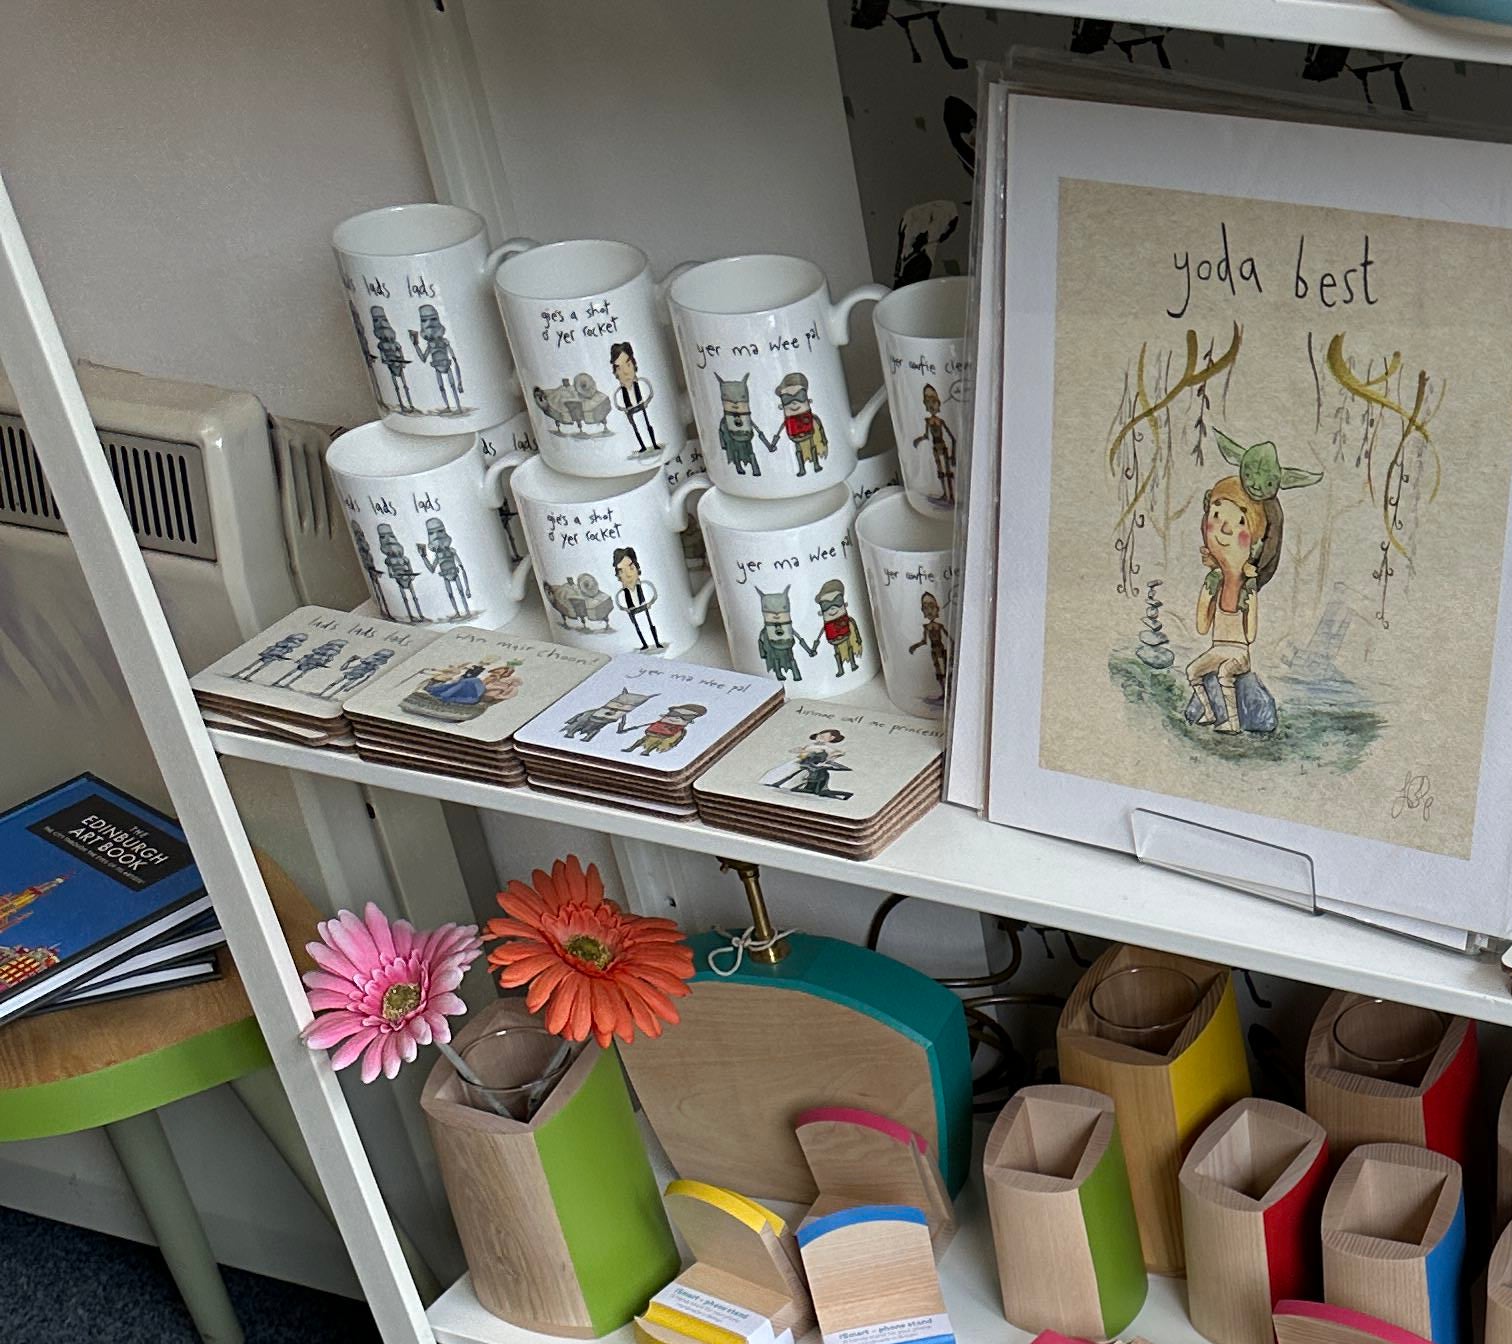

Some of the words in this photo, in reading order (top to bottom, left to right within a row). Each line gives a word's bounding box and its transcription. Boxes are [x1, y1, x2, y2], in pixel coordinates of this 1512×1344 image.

[1167, 222, 1263, 318] yoda
[1295, 234, 1378, 308] best
[361, 274, 391, 299] lads
[407, 275, 436, 298] lads
[570, 311, 579, 321] a
[586, 299, 611, 319] shot
[556, 330, 576, 348] yer
[582, 316, 619, 338] rocket
[696, 343, 721, 369] yer
[732, 345, 759, 356] ma
[769, 335, 800, 352] wee
[805, 320, 821, 352] pal
[512, 431, 539, 453] lads
[367, 495, 398, 517] lads
[412, 492, 442, 514] lads
[574, 516, 582, 526] a
[589, 507, 614, 525] shot
[561, 533, 579, 550] yer
[585, 523, 623, 542] rocket
[735, 559, 763, 584] yer
[773, 557, 800, 571] ma
[809, 546, 838, 562] wee
[841, 527, 854, 560] pal
[884, 567, 900, 587] yer
[310, 616, 338, 632] lads
[348, 623, 376, 639] lads
[626, 665, 666, 680] yer
[670, 672, 694, 683] ma
[699, 679, 724, 690] wee
[726, 682, 752, 696] pal
[841, 715, 865, 725] call
[869, 720, 886, 728] me
[81, 814, 170, 866] EDINBURGH
[128, 824, 150, 839] THE
[67, 827, 104, 846] ART
[97, 841, 149, 872] BOOK
